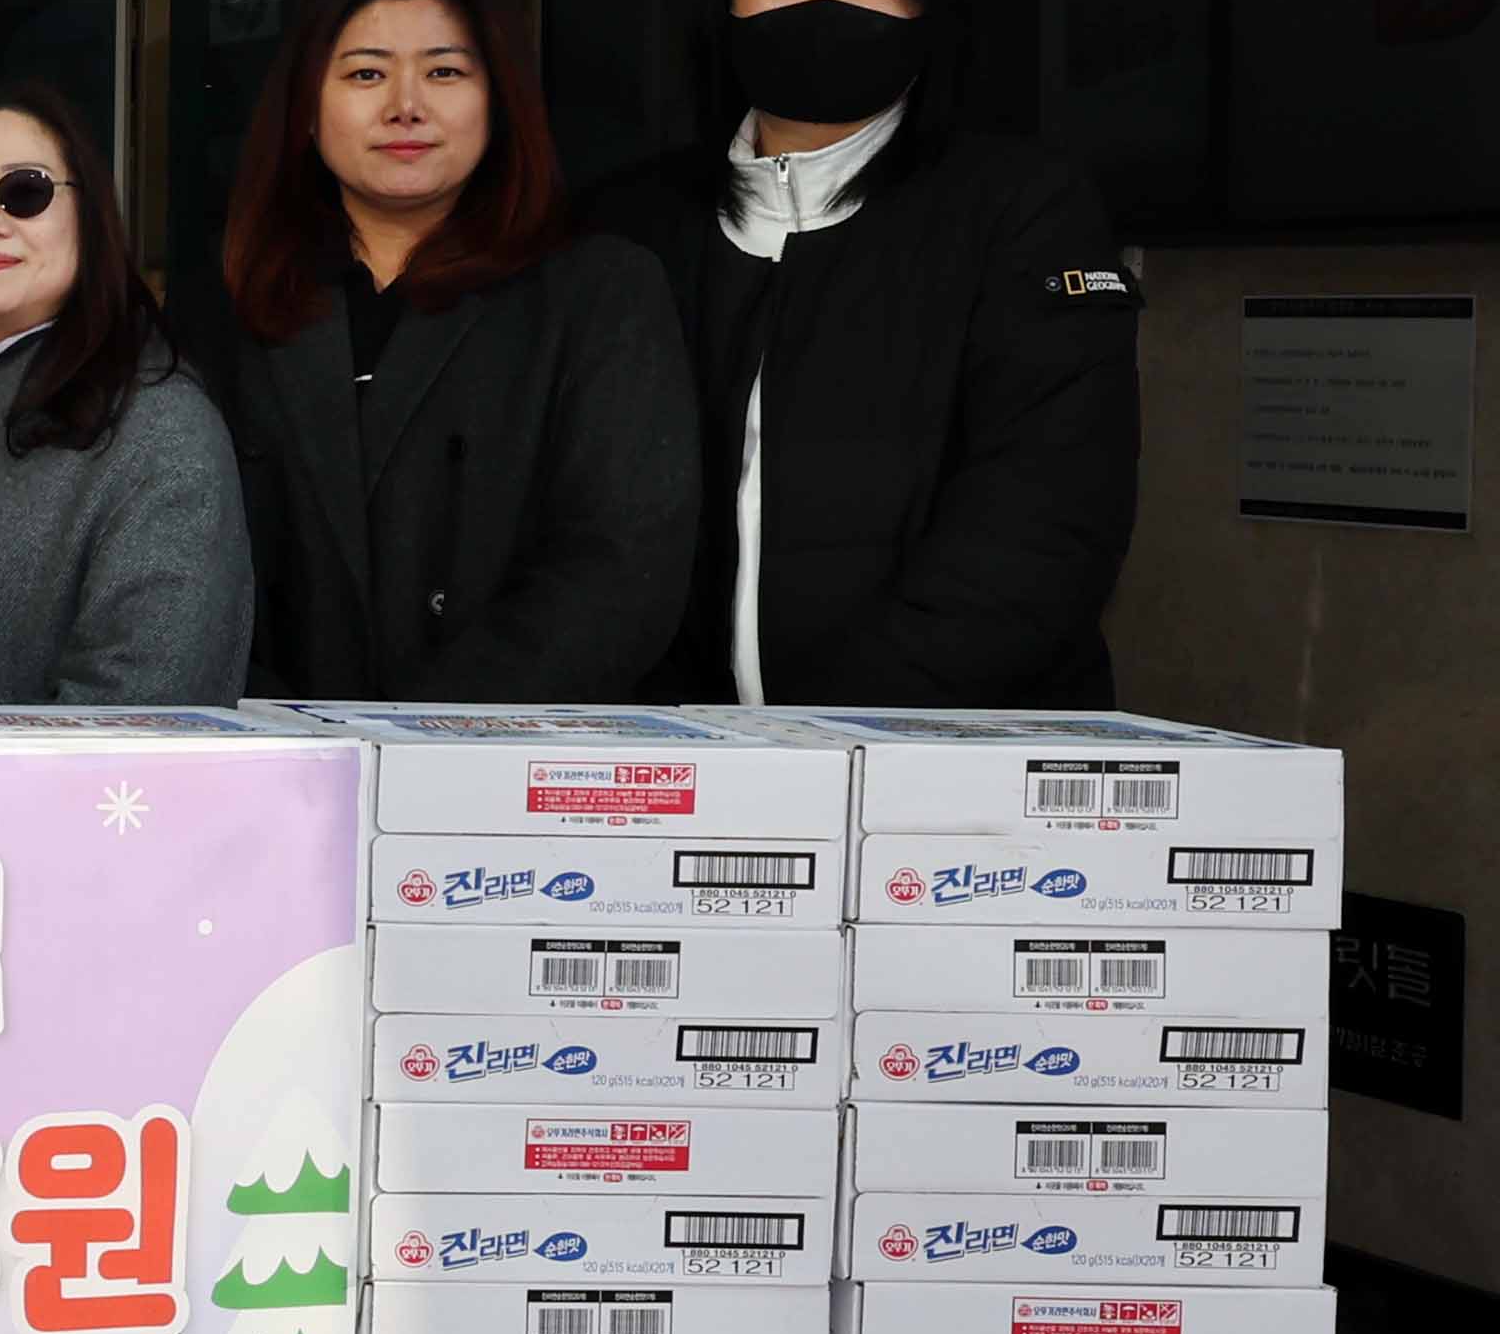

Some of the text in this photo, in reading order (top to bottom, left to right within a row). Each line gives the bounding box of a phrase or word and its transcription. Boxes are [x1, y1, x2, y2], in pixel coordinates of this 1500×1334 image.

[443, 866, 587, 909] 진라면 순한맛
[931, 864, 1080, 907] 진라면 순한맛
[696, 898, 787, 915] 52 121
[1080, 899, 1097, 909] 120
[1190, 895, 1283, 911] 52 121
[1331, 936, 1431, 1008] 릿돌
